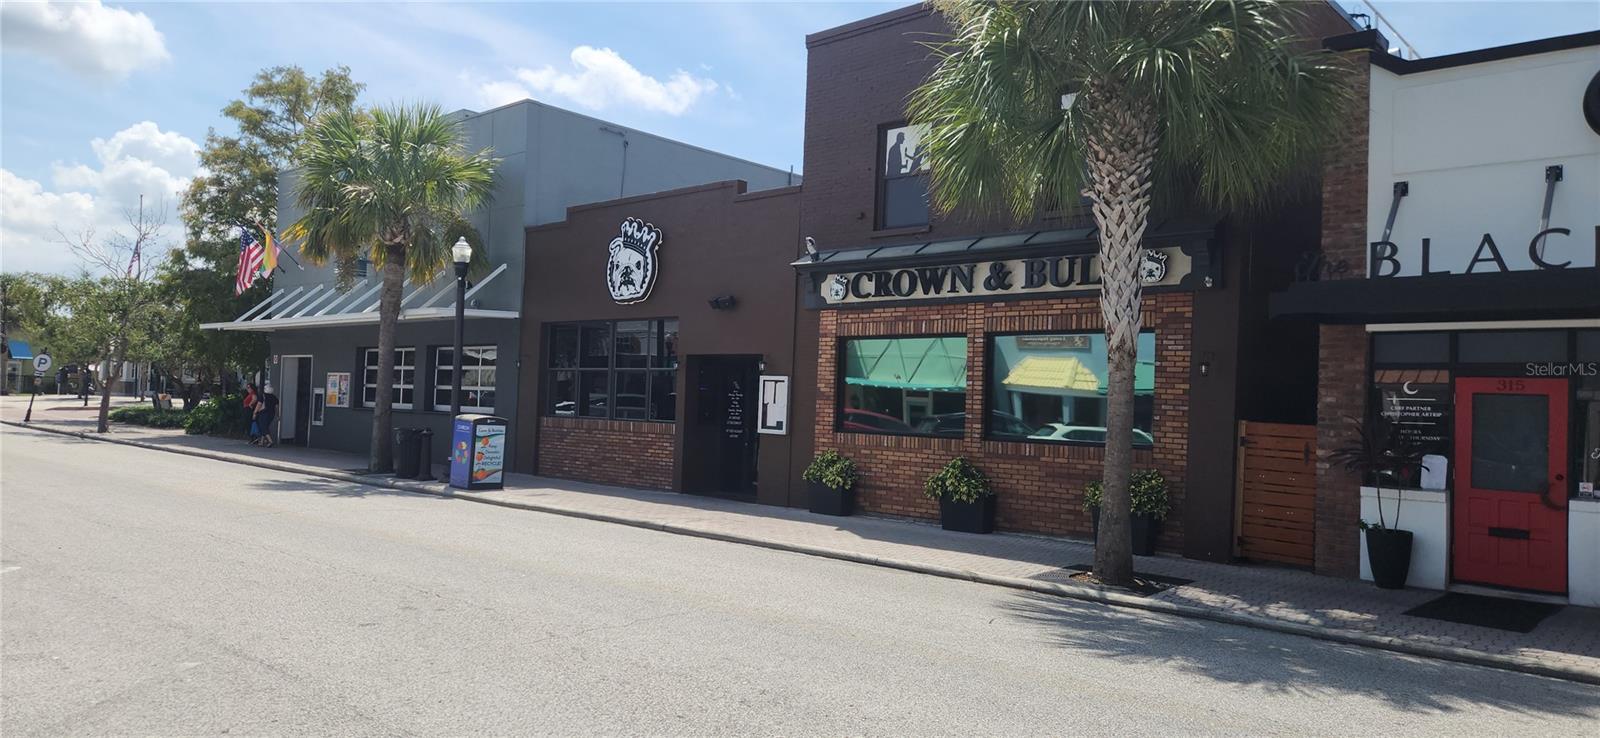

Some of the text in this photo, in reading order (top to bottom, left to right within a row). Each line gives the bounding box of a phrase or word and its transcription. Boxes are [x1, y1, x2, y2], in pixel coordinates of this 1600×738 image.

[1370, 225, 1600, 279] BLAC
[851, 263, 977, 299] CROWN
[983, 262, 1015, 291] &
[38, 358, 48, 368] P
[1496, 379, 1526, 391] 315
